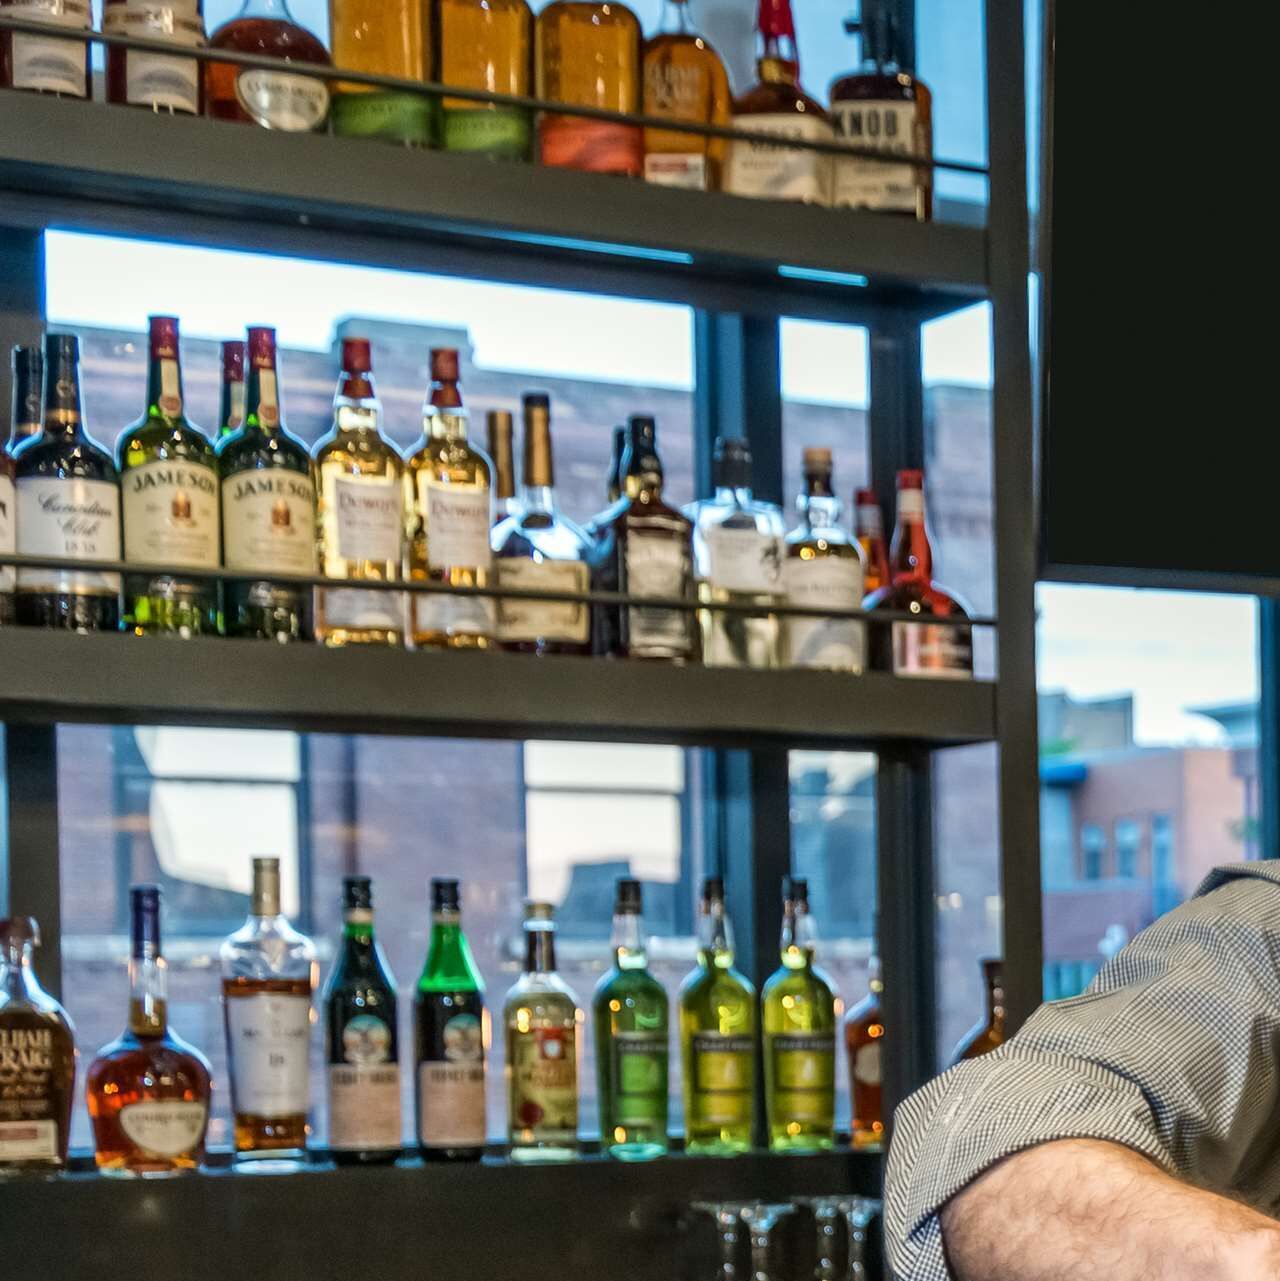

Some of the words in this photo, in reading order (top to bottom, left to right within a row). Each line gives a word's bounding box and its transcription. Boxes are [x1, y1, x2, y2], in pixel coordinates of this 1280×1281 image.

[832, 108, 898, 138] KNOB
[133, 470, 216, 494] JAMESON
[0, 1029, 52, 1049] LIJAH
[0, 1049, 52, 1070] RAIG
